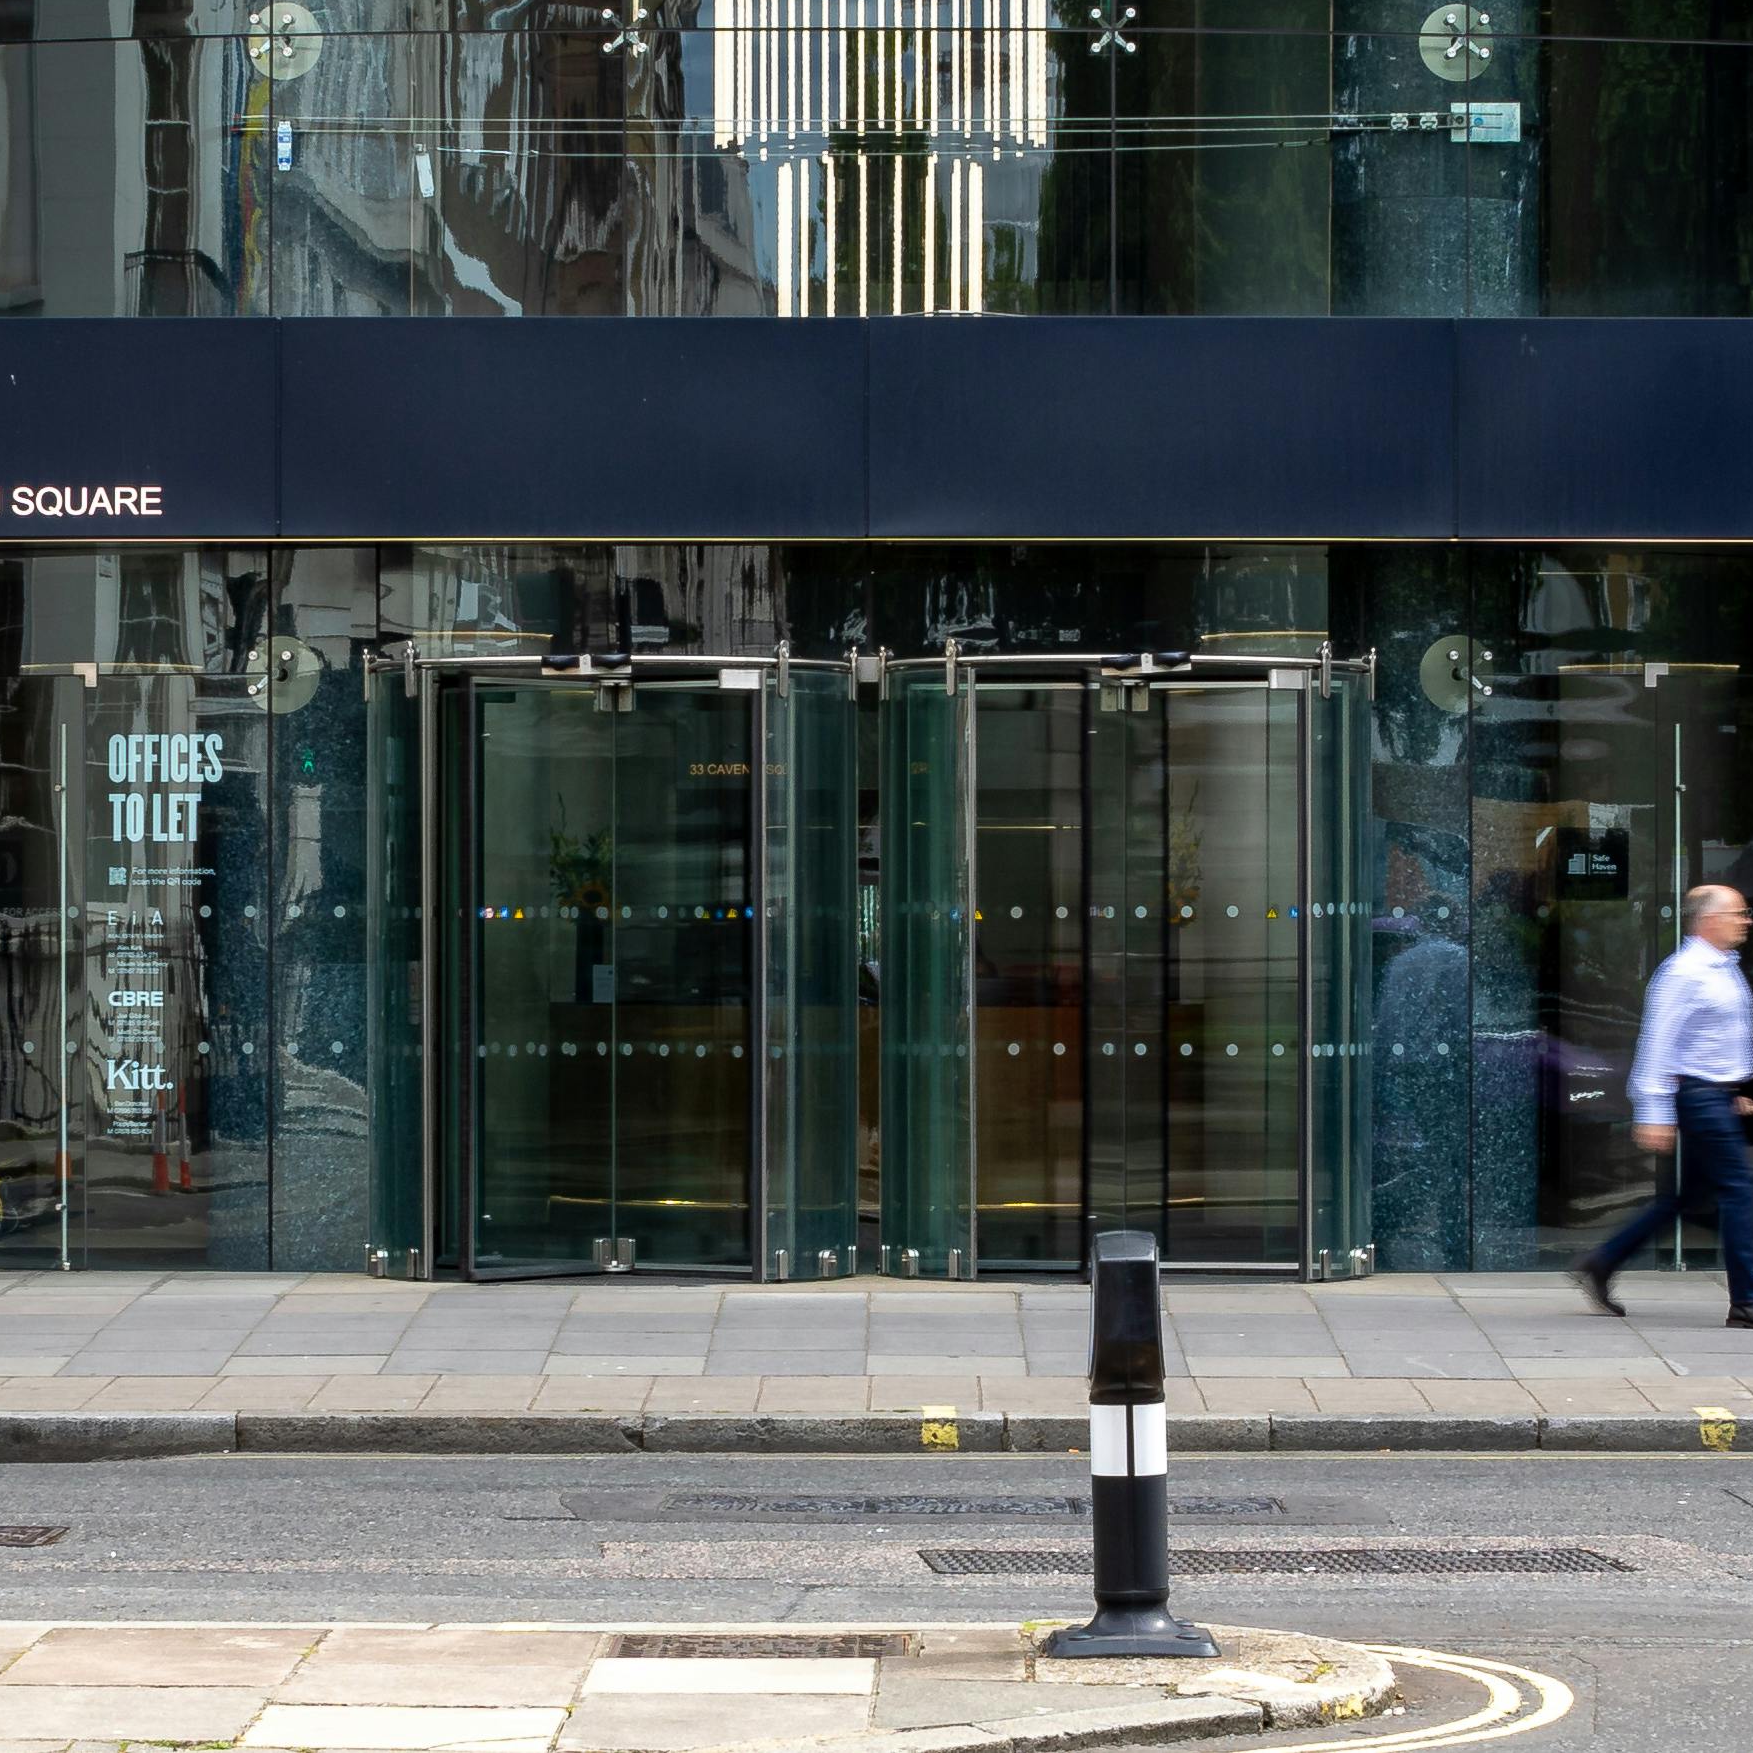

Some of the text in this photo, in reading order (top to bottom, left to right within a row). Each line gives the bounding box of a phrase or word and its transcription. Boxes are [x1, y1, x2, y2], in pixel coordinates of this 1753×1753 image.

[11, 487, 163, 517] SQUARE
[108, 733, 223, 783] OFFICES
[690, 763, 704, 775] 33
[707, 763, 750, 775] CAVEN
[108, 792, 201, 843] TO LET
[1592, 854, 1610, 862] Safe
[132, 867, 146, 875] For
[1591, 863, 1617, 871] Haven
[167, 877, 180, 886] QR
[107, 991, 163, 1006] CBRE
[106, 1059, 174, 1090] Kitt.
